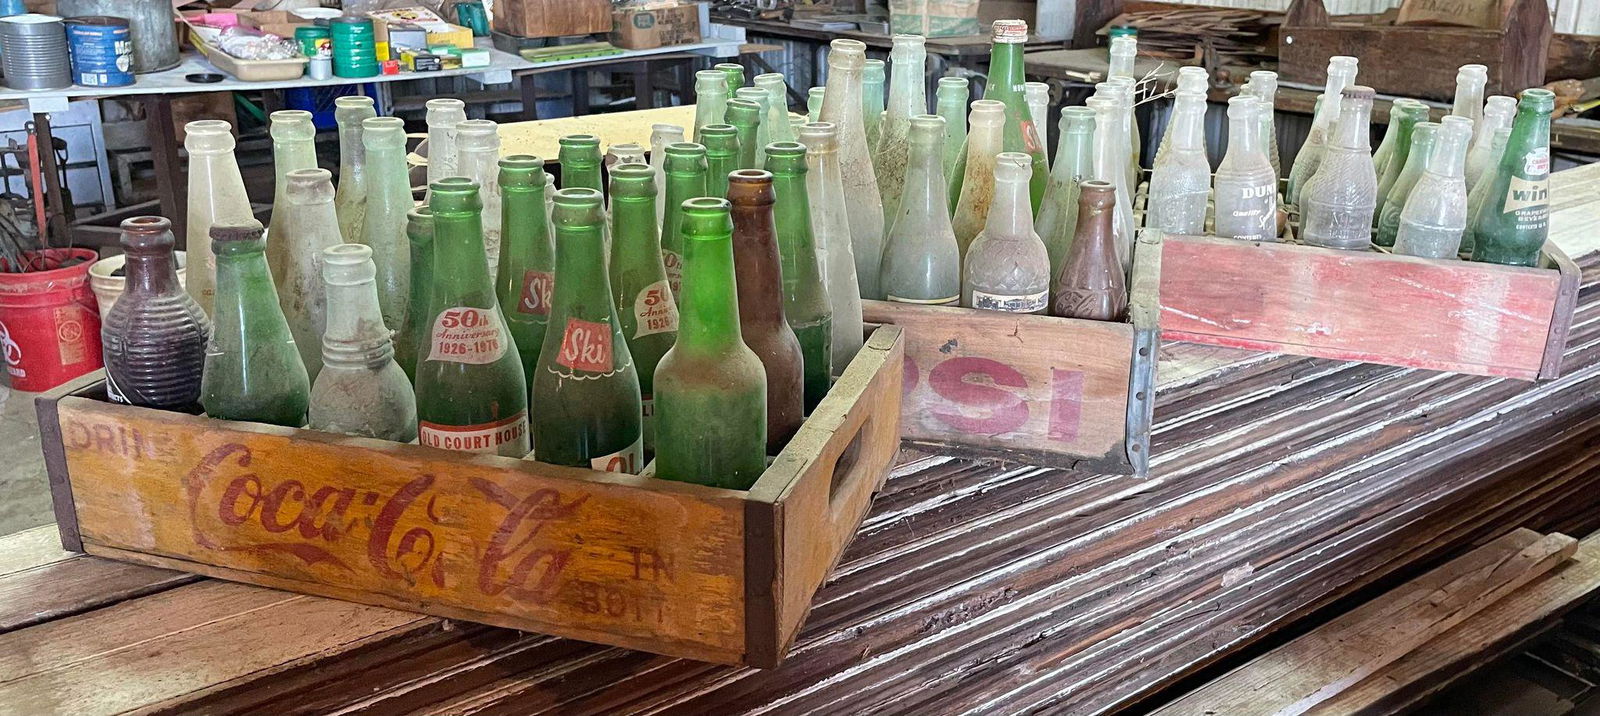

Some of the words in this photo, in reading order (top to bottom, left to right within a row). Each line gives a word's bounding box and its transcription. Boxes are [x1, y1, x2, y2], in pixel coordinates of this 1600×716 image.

[441, 309, 489, 329] 50th
[439, 338, 499, 355] 1926-1976
[565, 327, 605, 364] Ski
[444, 433, 491, 450] COURT
[495, 420, 526, 446] HOUSE
